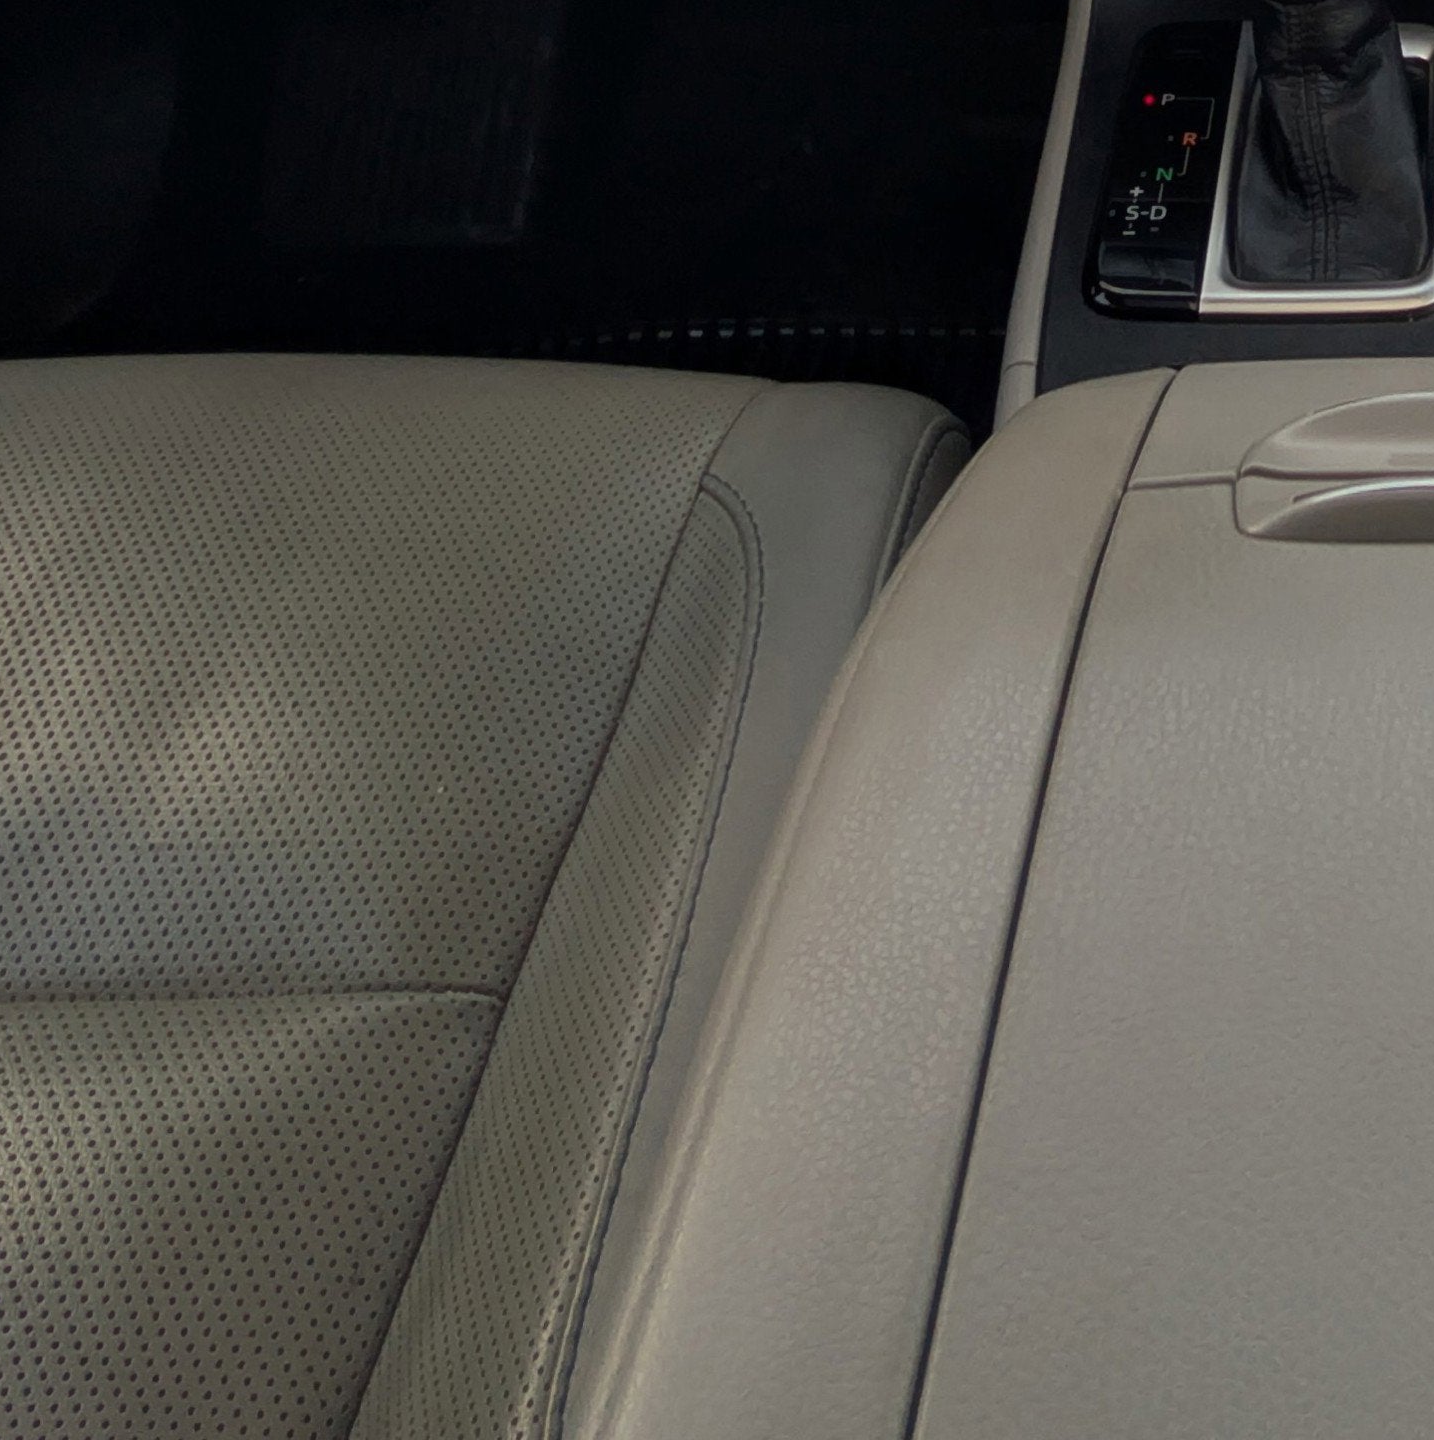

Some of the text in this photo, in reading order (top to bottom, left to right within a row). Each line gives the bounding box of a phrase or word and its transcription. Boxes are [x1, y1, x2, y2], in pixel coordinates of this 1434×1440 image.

[1161, 92, 1176, 107] P
[1182, 131, 1197, 146] R
[1155, 166, 1174, 181] N
